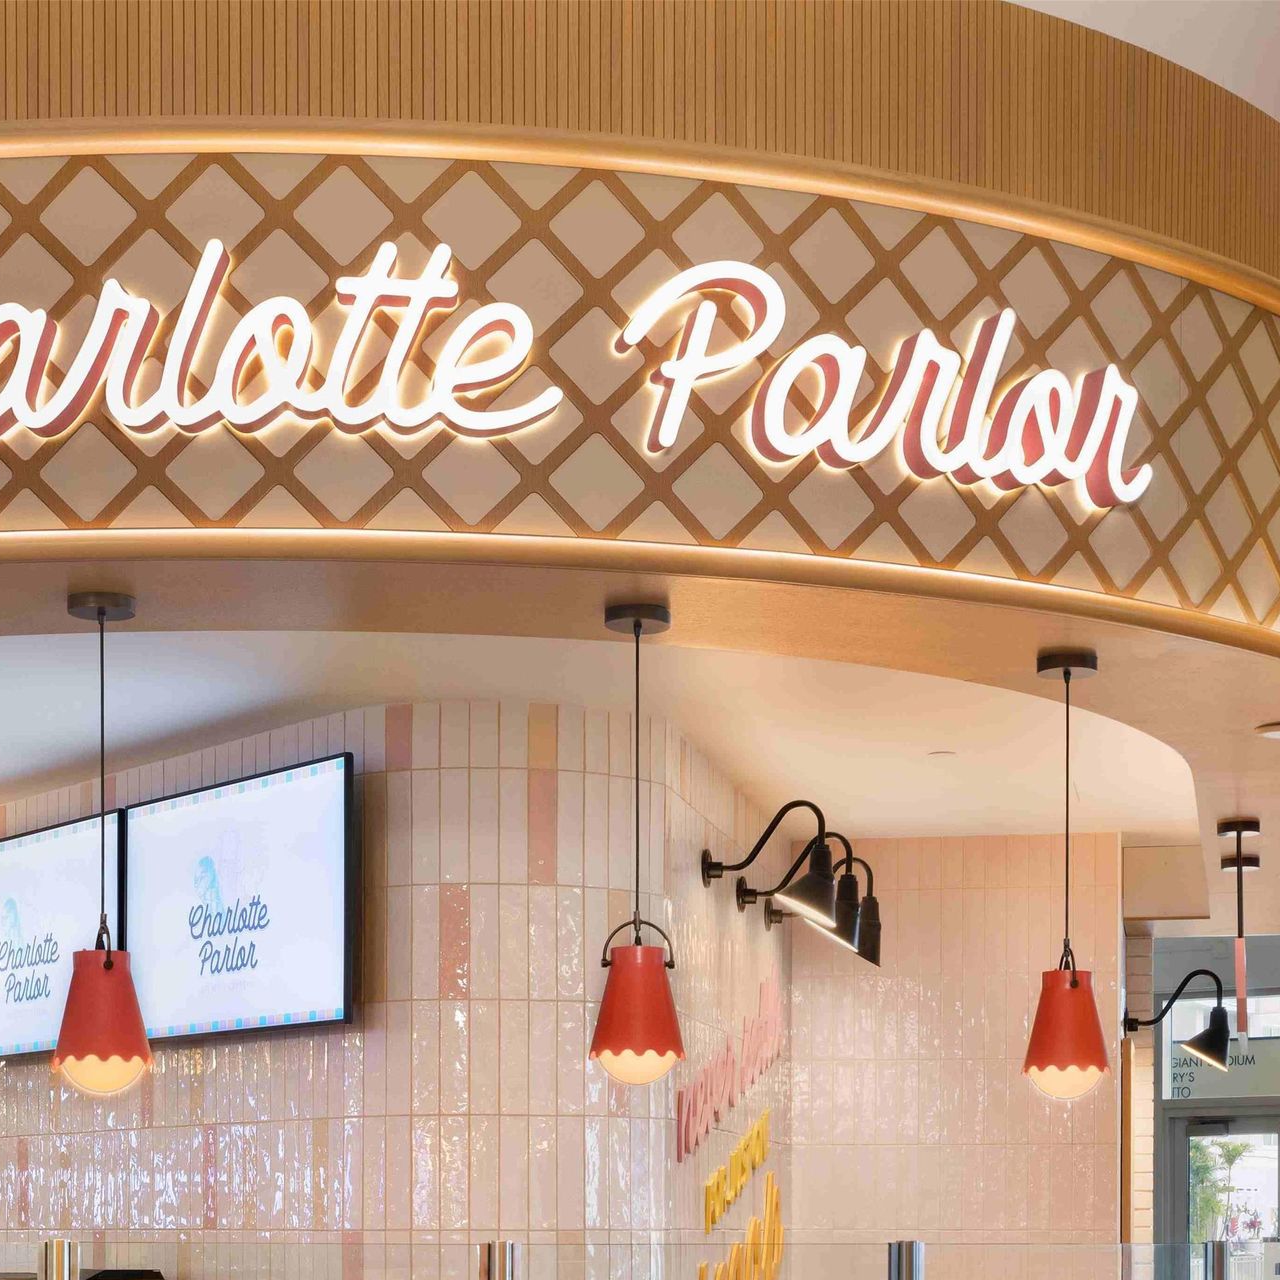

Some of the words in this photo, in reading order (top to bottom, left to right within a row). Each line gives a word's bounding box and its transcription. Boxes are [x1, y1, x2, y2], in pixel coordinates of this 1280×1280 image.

[612, 257, 1154, 507] Parlor
[189, 895, 270, 939] Charlotte
[199, 938, 258, 977] Parlor
[4, 972, 51, 1005] Parlor
